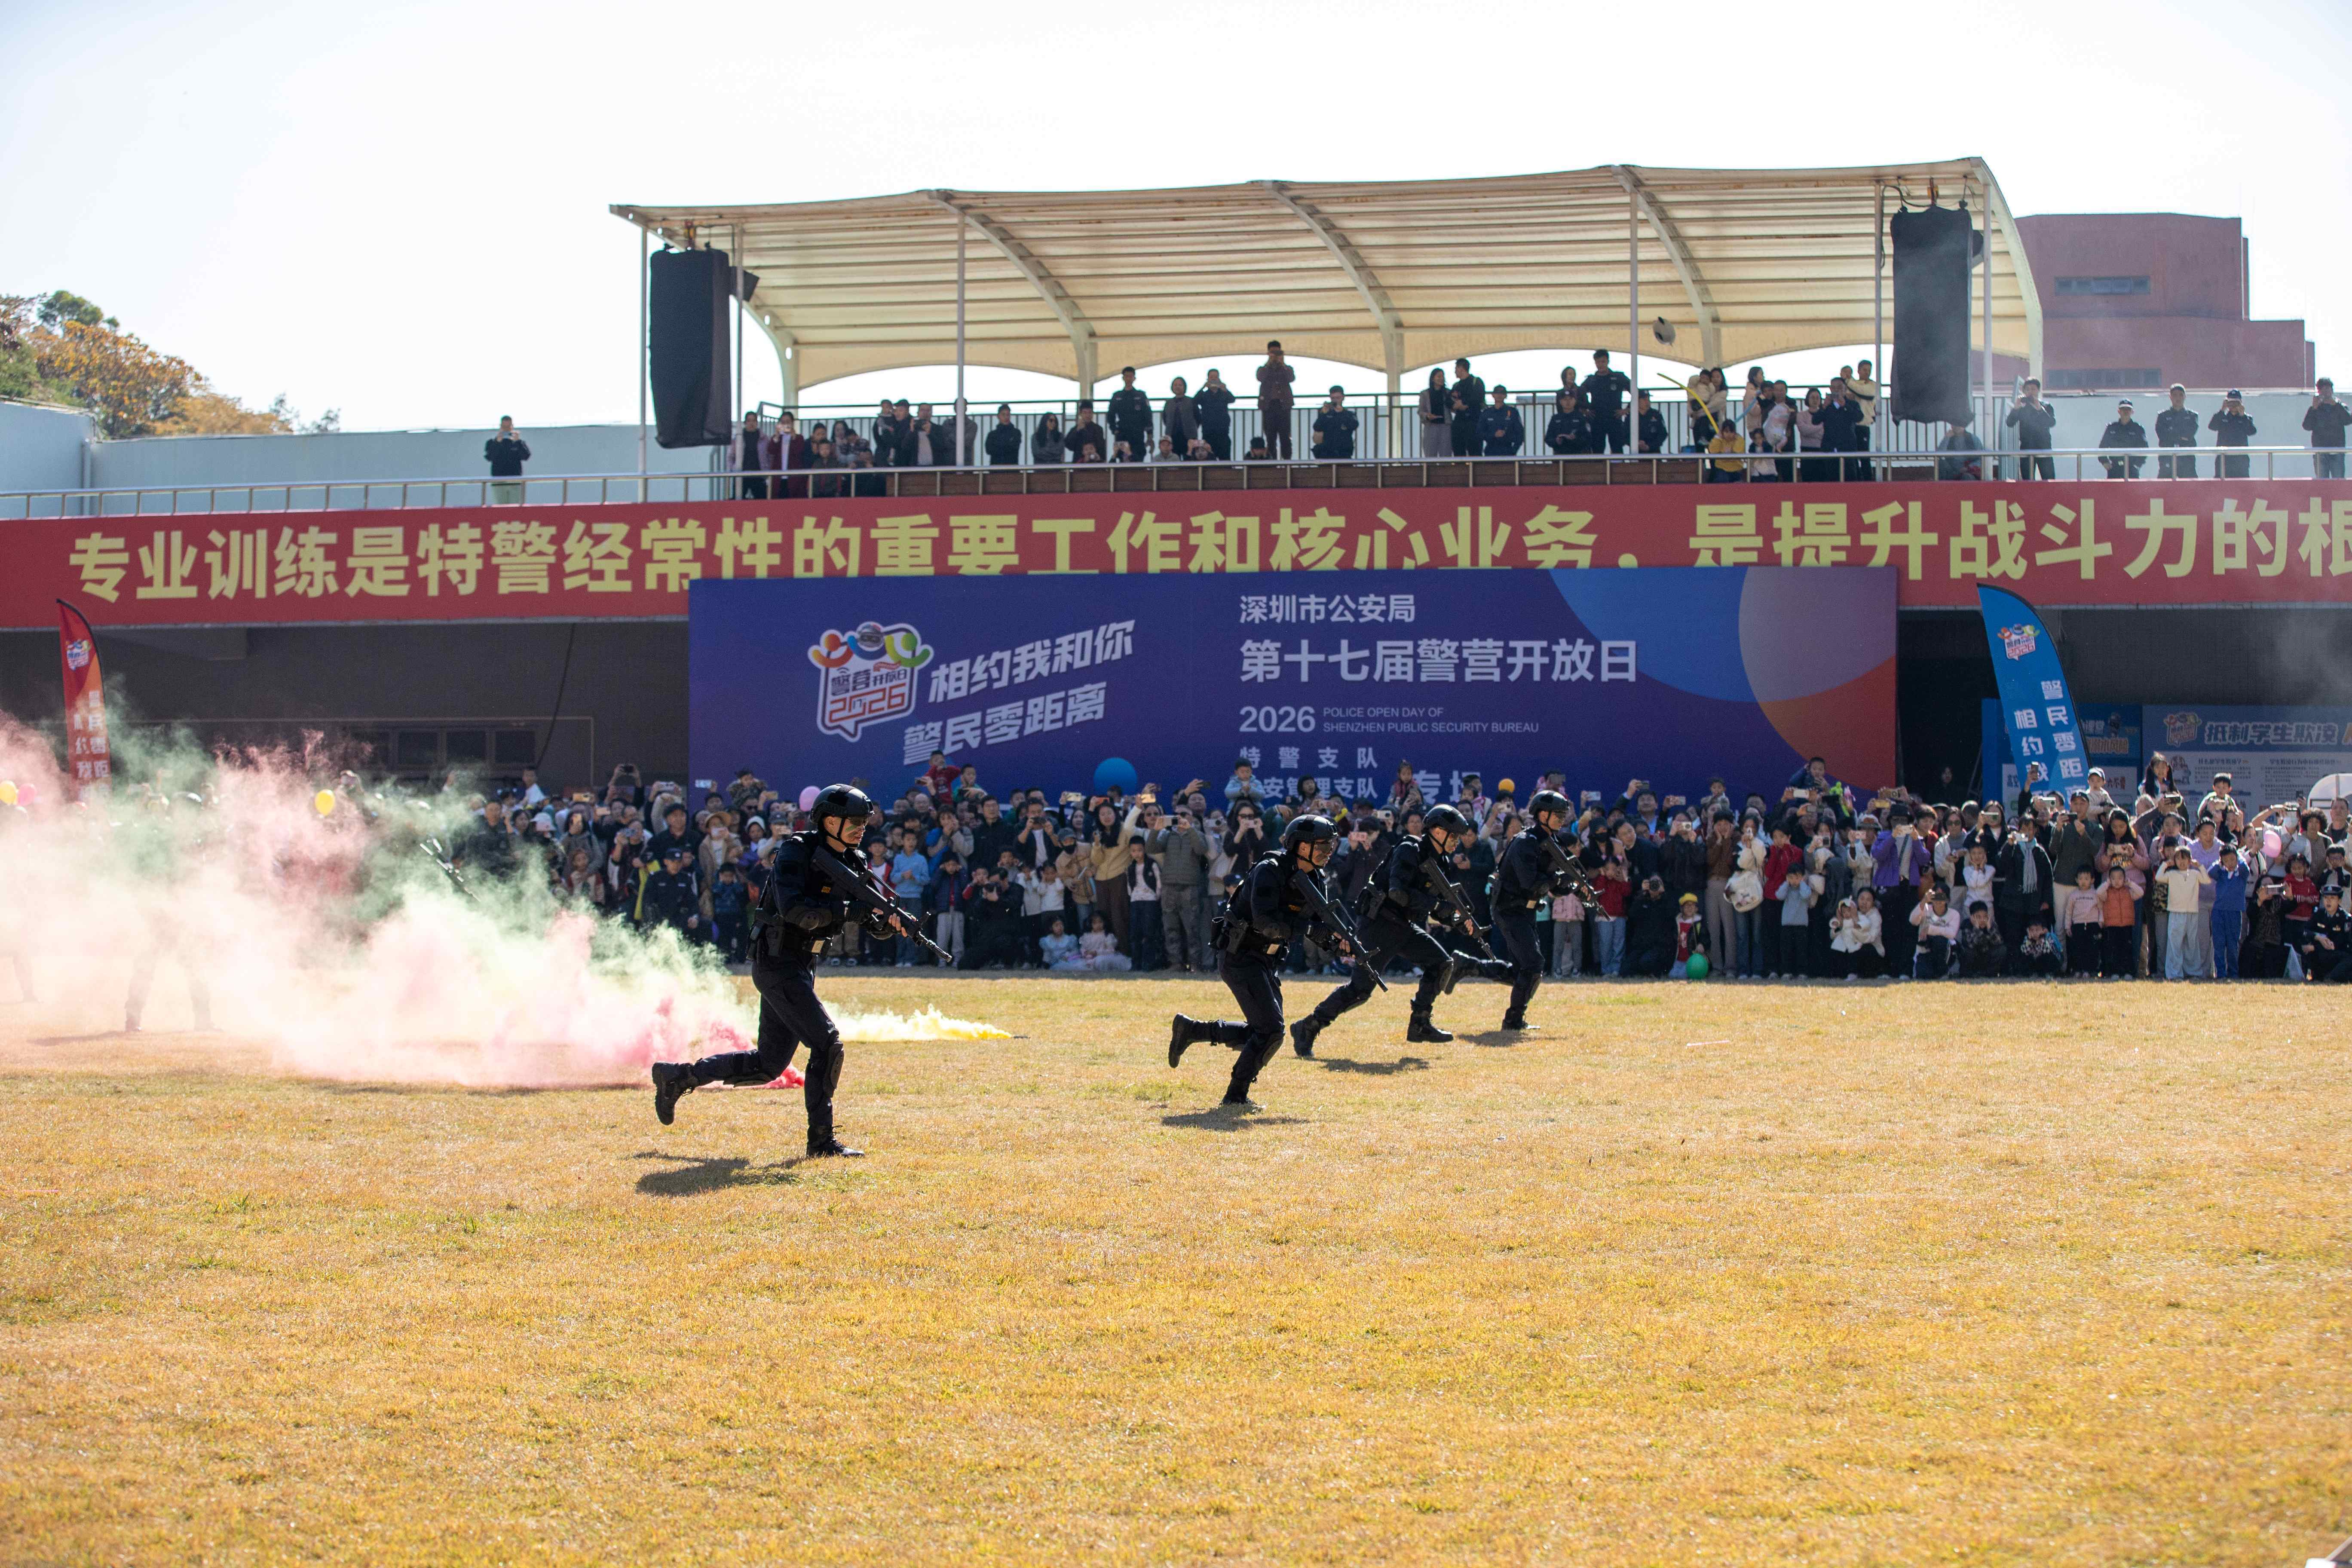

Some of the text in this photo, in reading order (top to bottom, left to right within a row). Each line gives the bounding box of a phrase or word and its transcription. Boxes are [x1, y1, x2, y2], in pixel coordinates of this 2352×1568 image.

[1240, 594, 1415, 624] 深圳市公安局
[928, 620, 1135, 703] 相约我和你
[1240, 638, 1636, 683] 第十七届警营开放日
[903, 682, 1107, 765] 警民零距离
[1239, 706, 1316, 732] 2026
[1323, 707, 1444, 717] POLICE OPEN DAY OF
[1323, 722, 1539, 732] SHENZHEN PUBLIC SECURITY BUREAU
